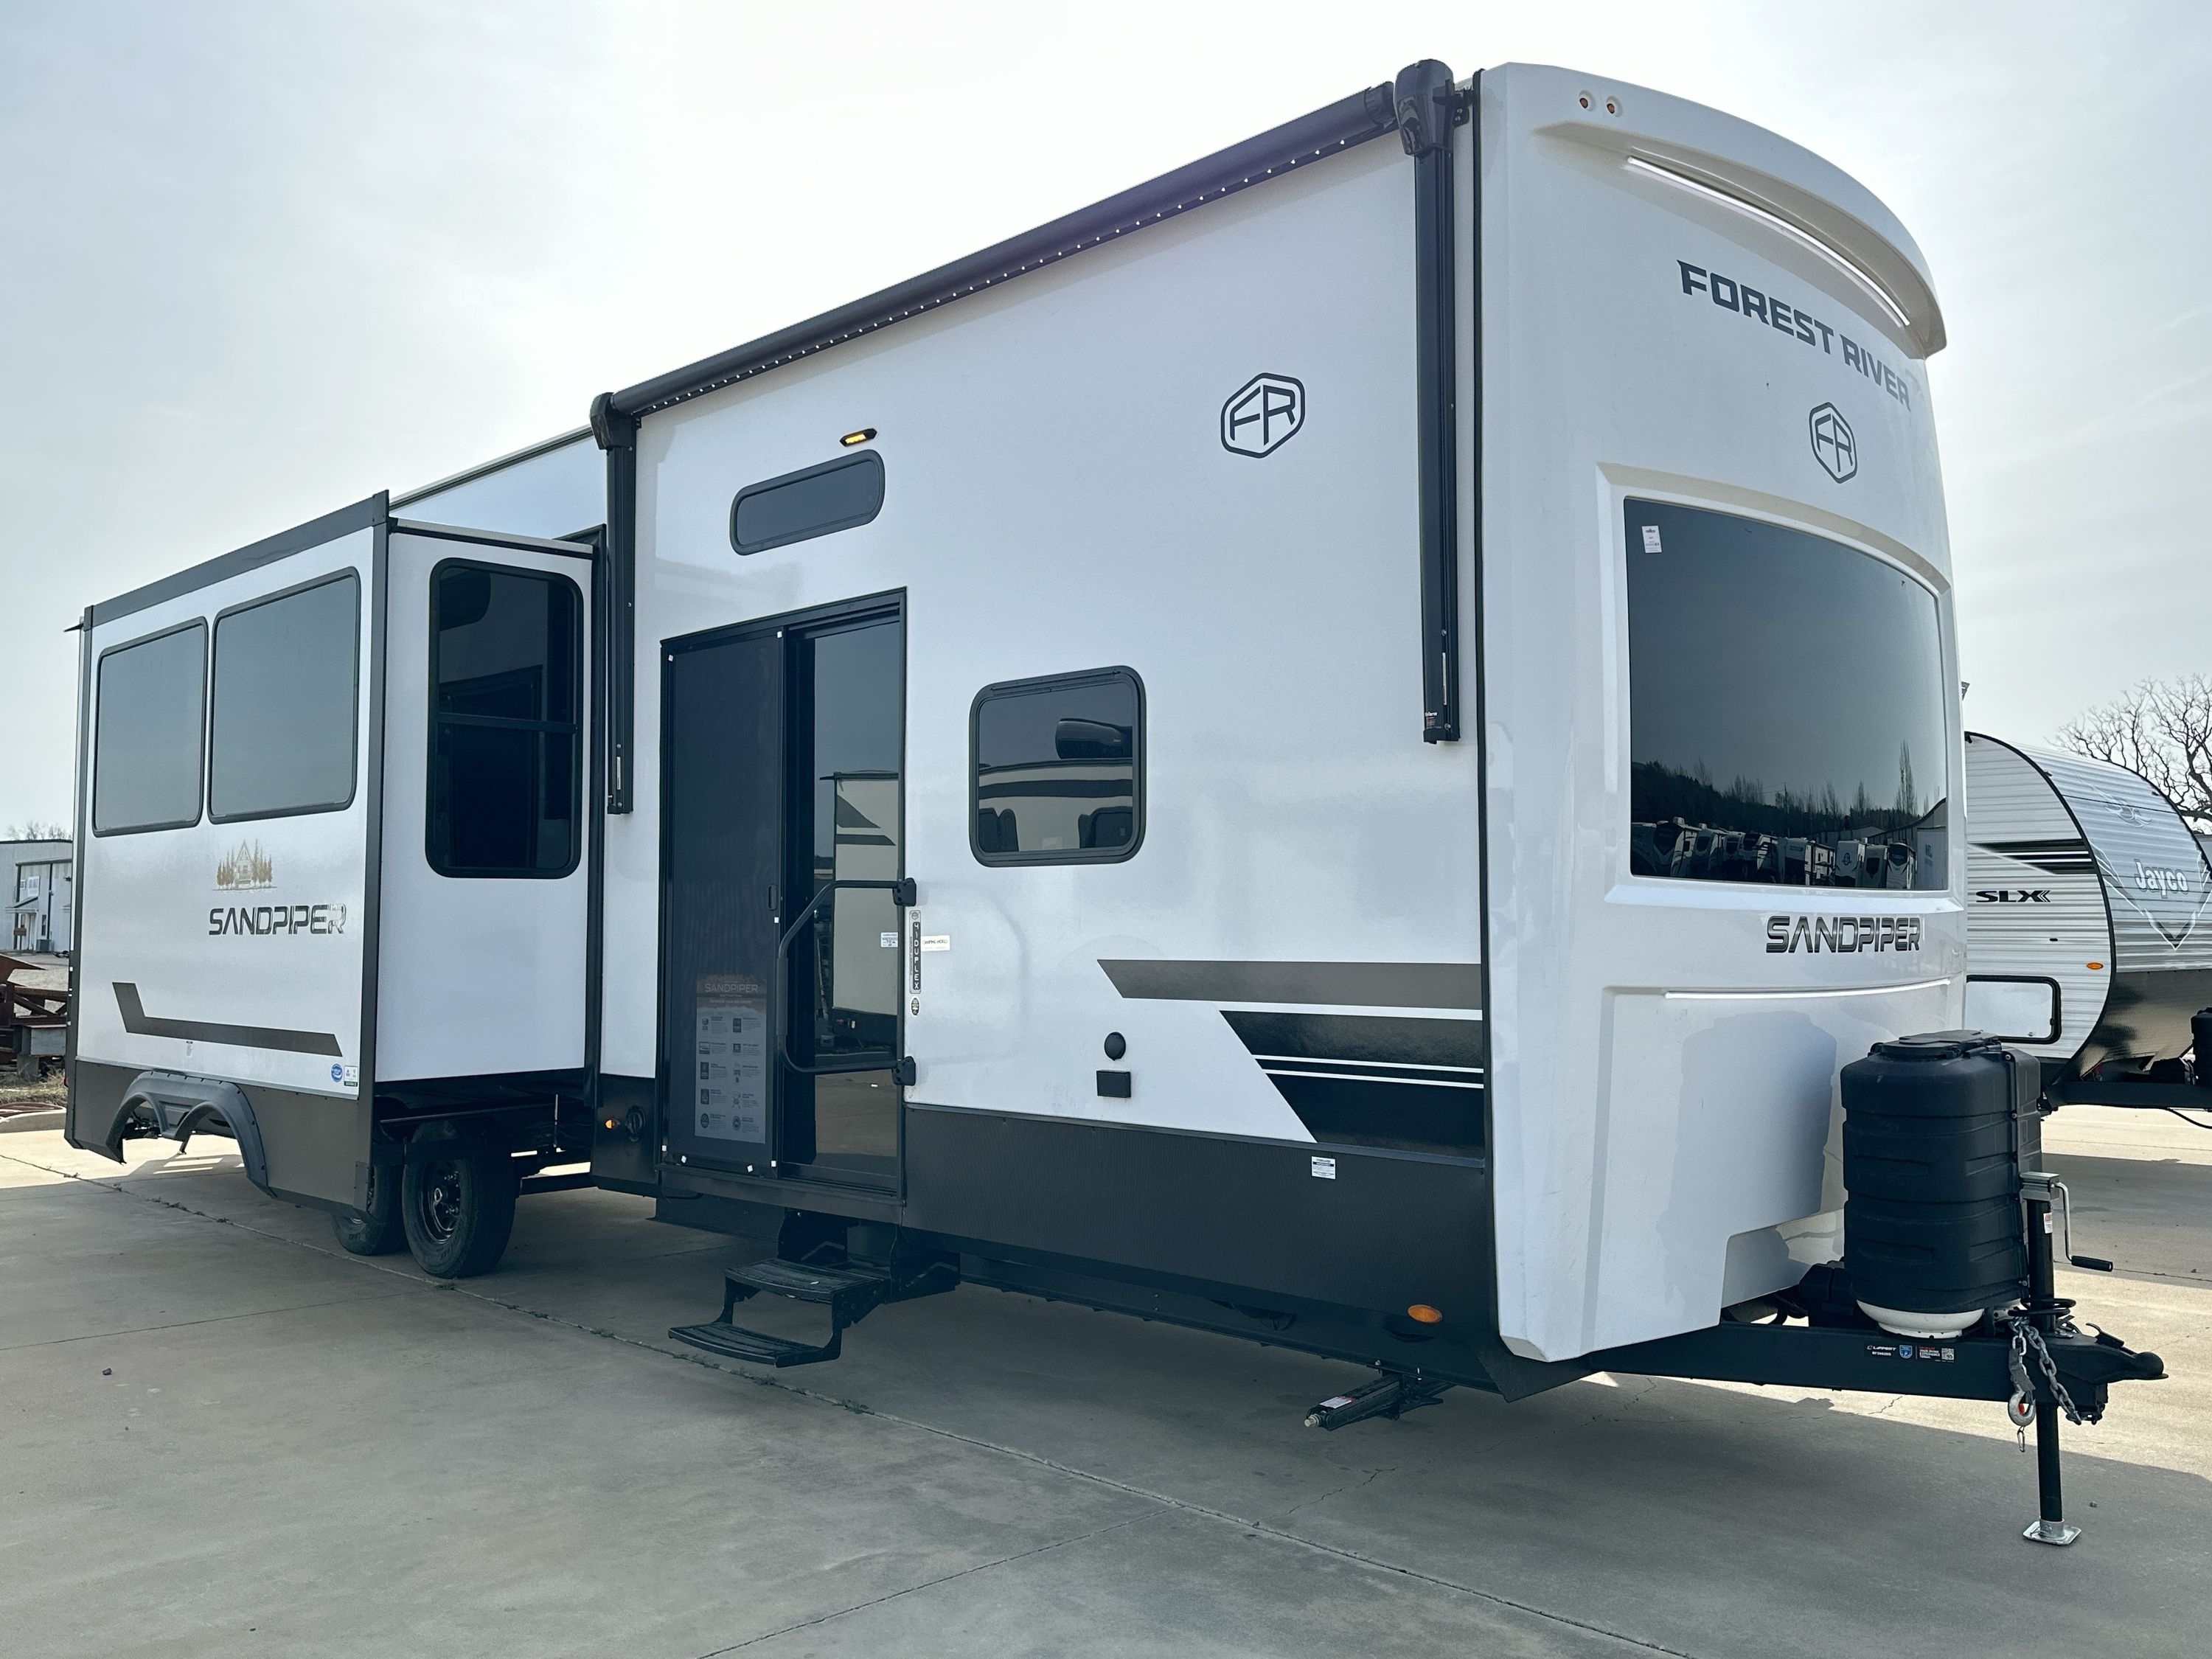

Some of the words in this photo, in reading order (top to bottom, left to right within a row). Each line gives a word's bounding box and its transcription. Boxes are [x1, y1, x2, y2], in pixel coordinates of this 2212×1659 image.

[1676, 259, 1834, 355] FOREST
[1839, 333, 1912, 413] RIVER
[1228, 382, 1297, 448] FR
[1813, 411, 1855, 475] FR
[1975, 889, 2051, 903] SLX
[2134, 858, 2189, 899] Jayco
[208, 903, 347, 936] SANDPIPER
[1766, 915, 1921, 953] SANDPIPER
[704, 983, 759, 993] SANDPIPER
